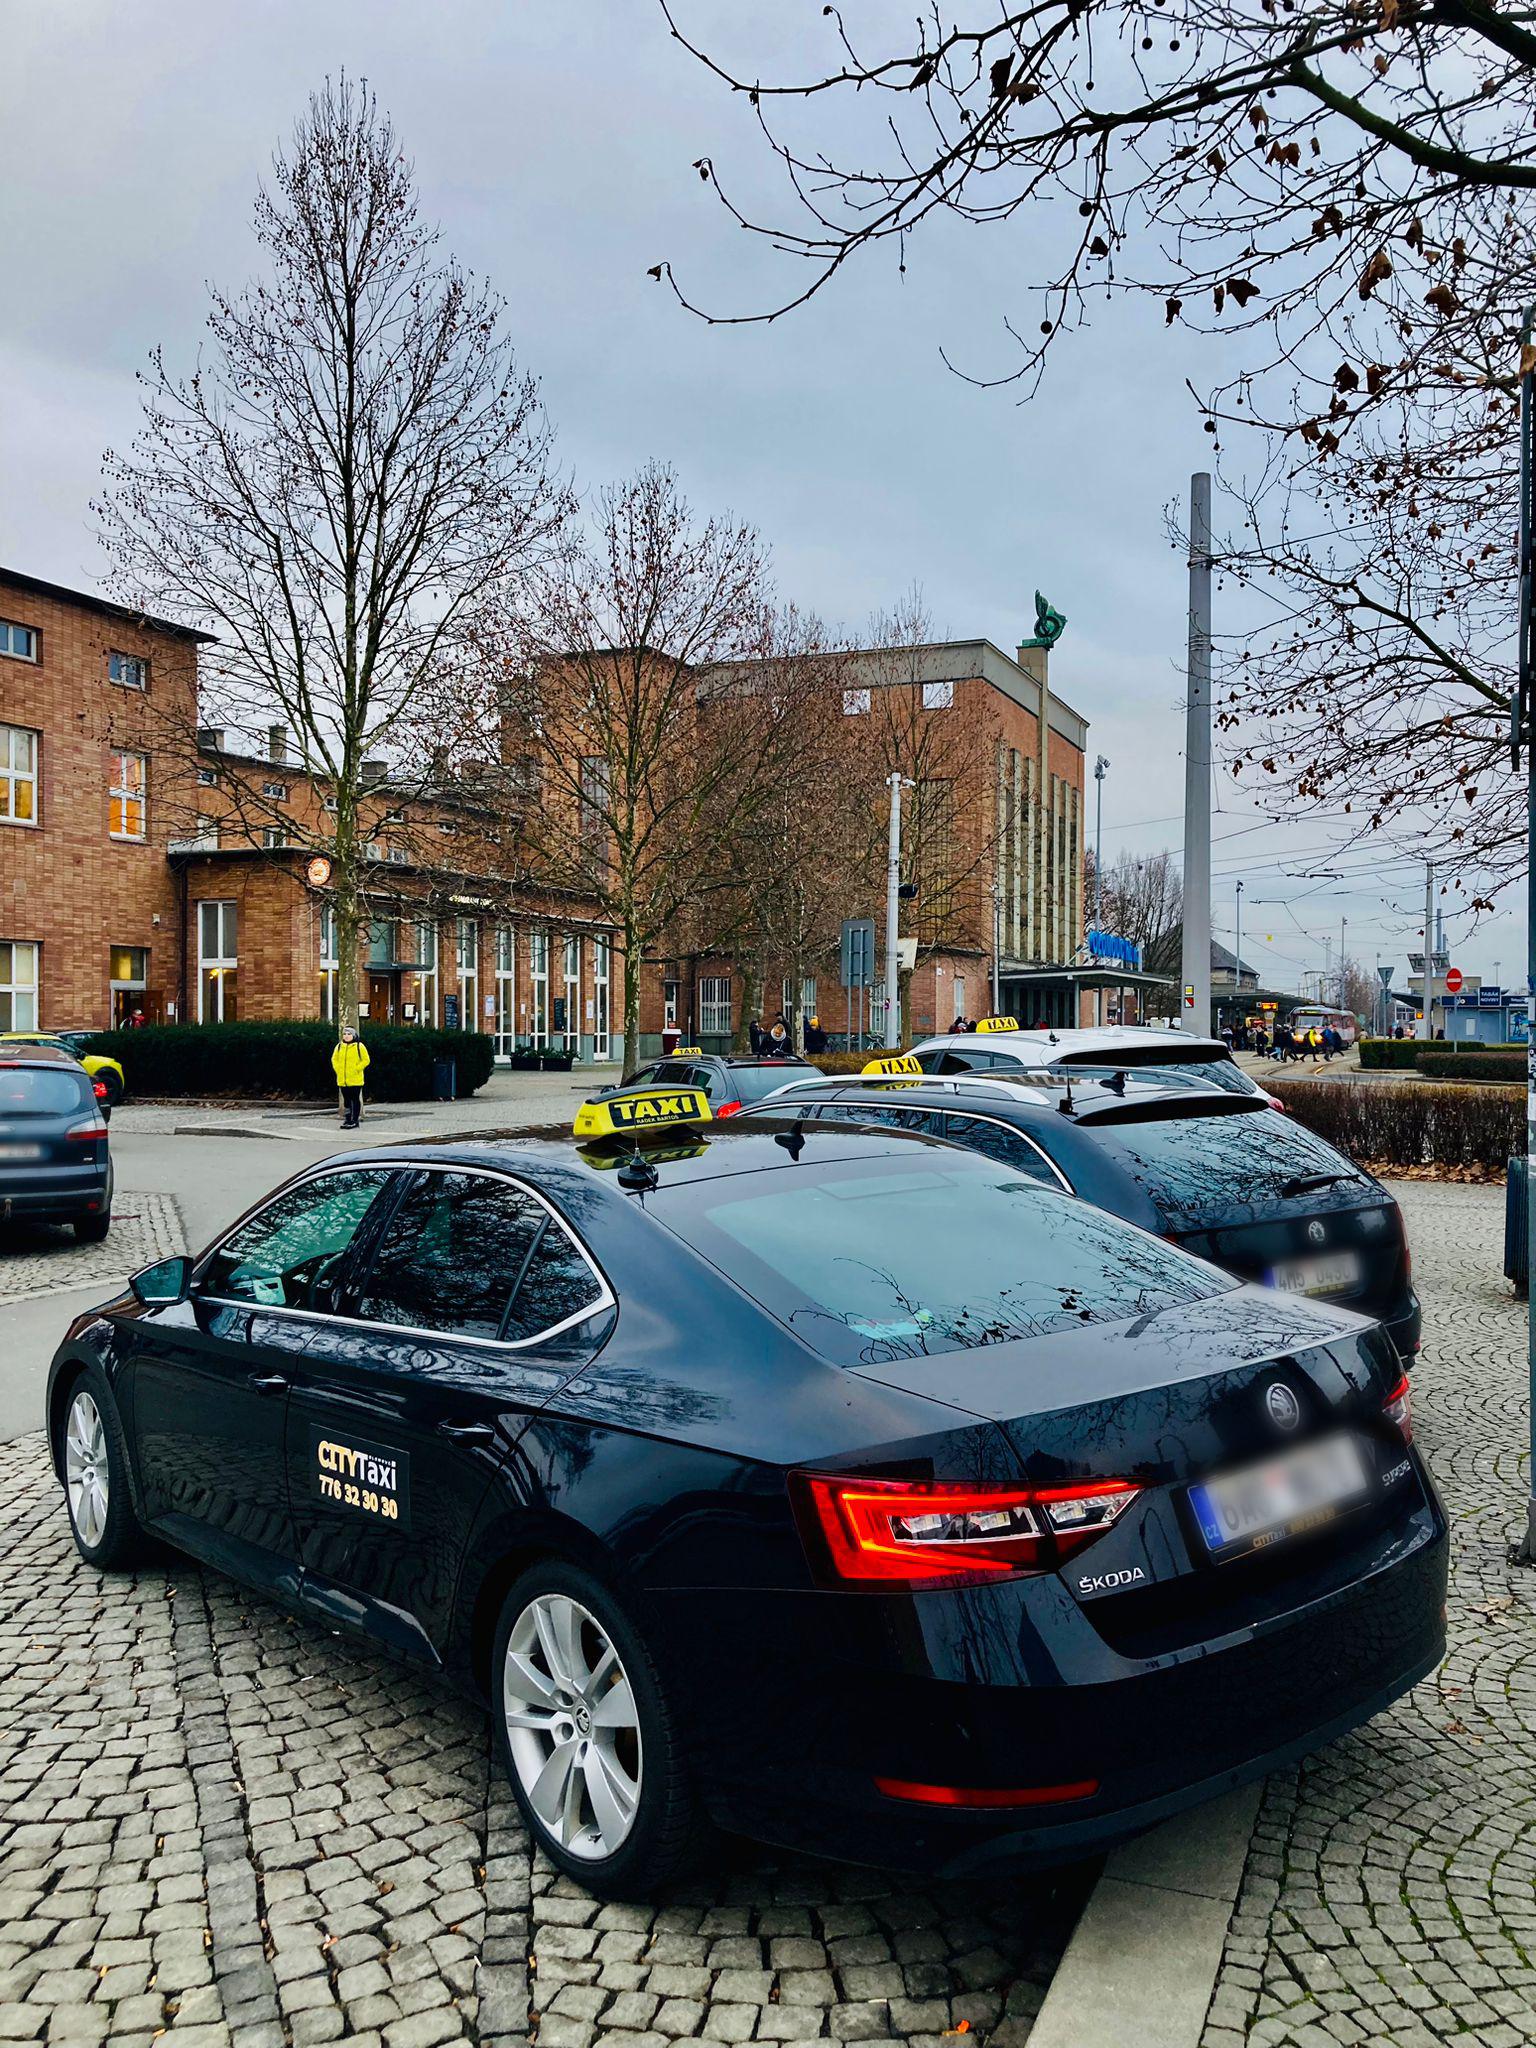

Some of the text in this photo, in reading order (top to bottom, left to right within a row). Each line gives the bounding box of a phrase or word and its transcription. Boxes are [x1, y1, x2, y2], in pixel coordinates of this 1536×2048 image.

[988, 1017, 1016, 1030] TAXI
[881, 1057, 917, 1075] TAXI
[614, 1096, 693, 1120] TAXI
[319, 1474, 398, 1520] 776 32 30 30
[1205, 1524, 1220, 1540] CZ
[1079, 1567, 1146, 1594] ŠKODA
